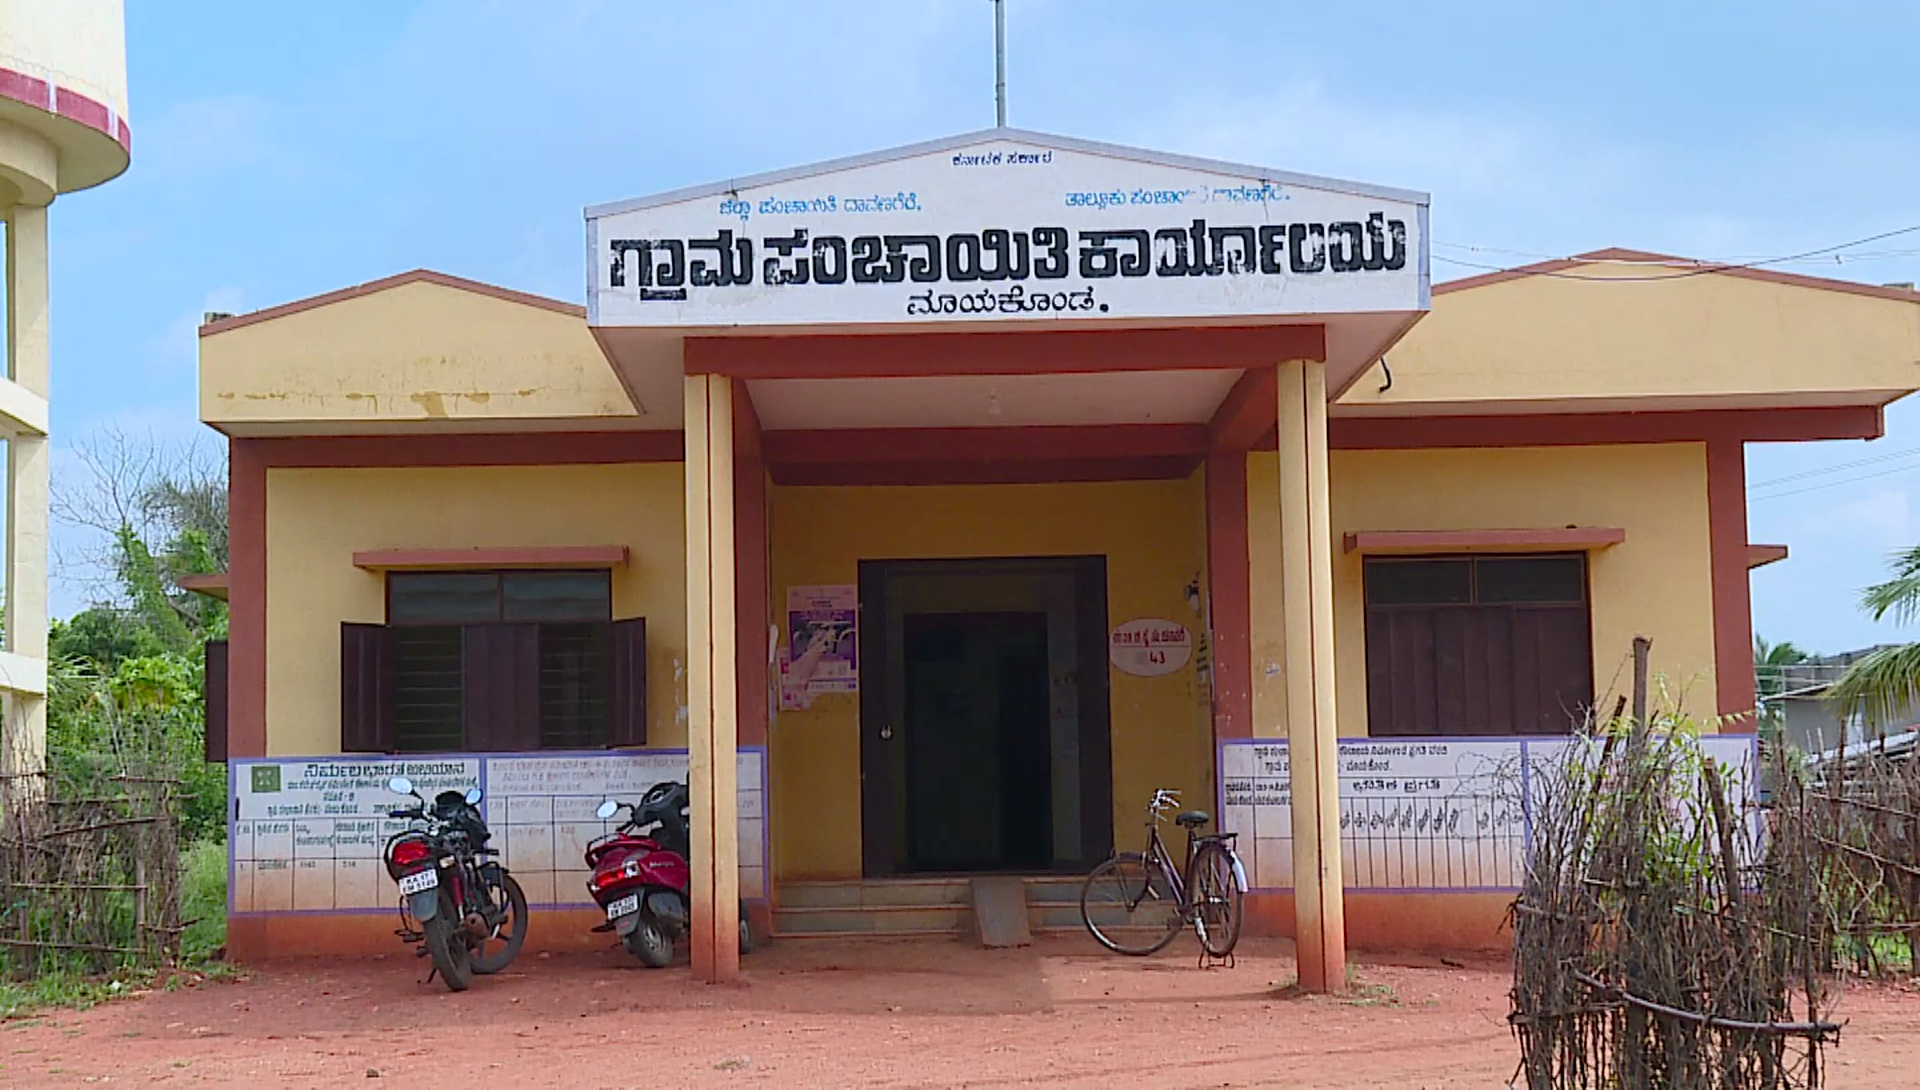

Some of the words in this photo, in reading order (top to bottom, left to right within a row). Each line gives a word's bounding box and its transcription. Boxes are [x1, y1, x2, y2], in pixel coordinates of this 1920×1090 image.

[610, 229, 753, 301] ಗ್ರಾಮ
[762, 226, 1069, 286] ಪಂಚಾಯಿತಿ
[1078, 212, 1407, 278] ಕಾರ್ಯಾಲಯ
[907, 285, 1110, 315] ಮಾಯಕೊಂಡ.
[1149, 651, 1166, 664] 43
